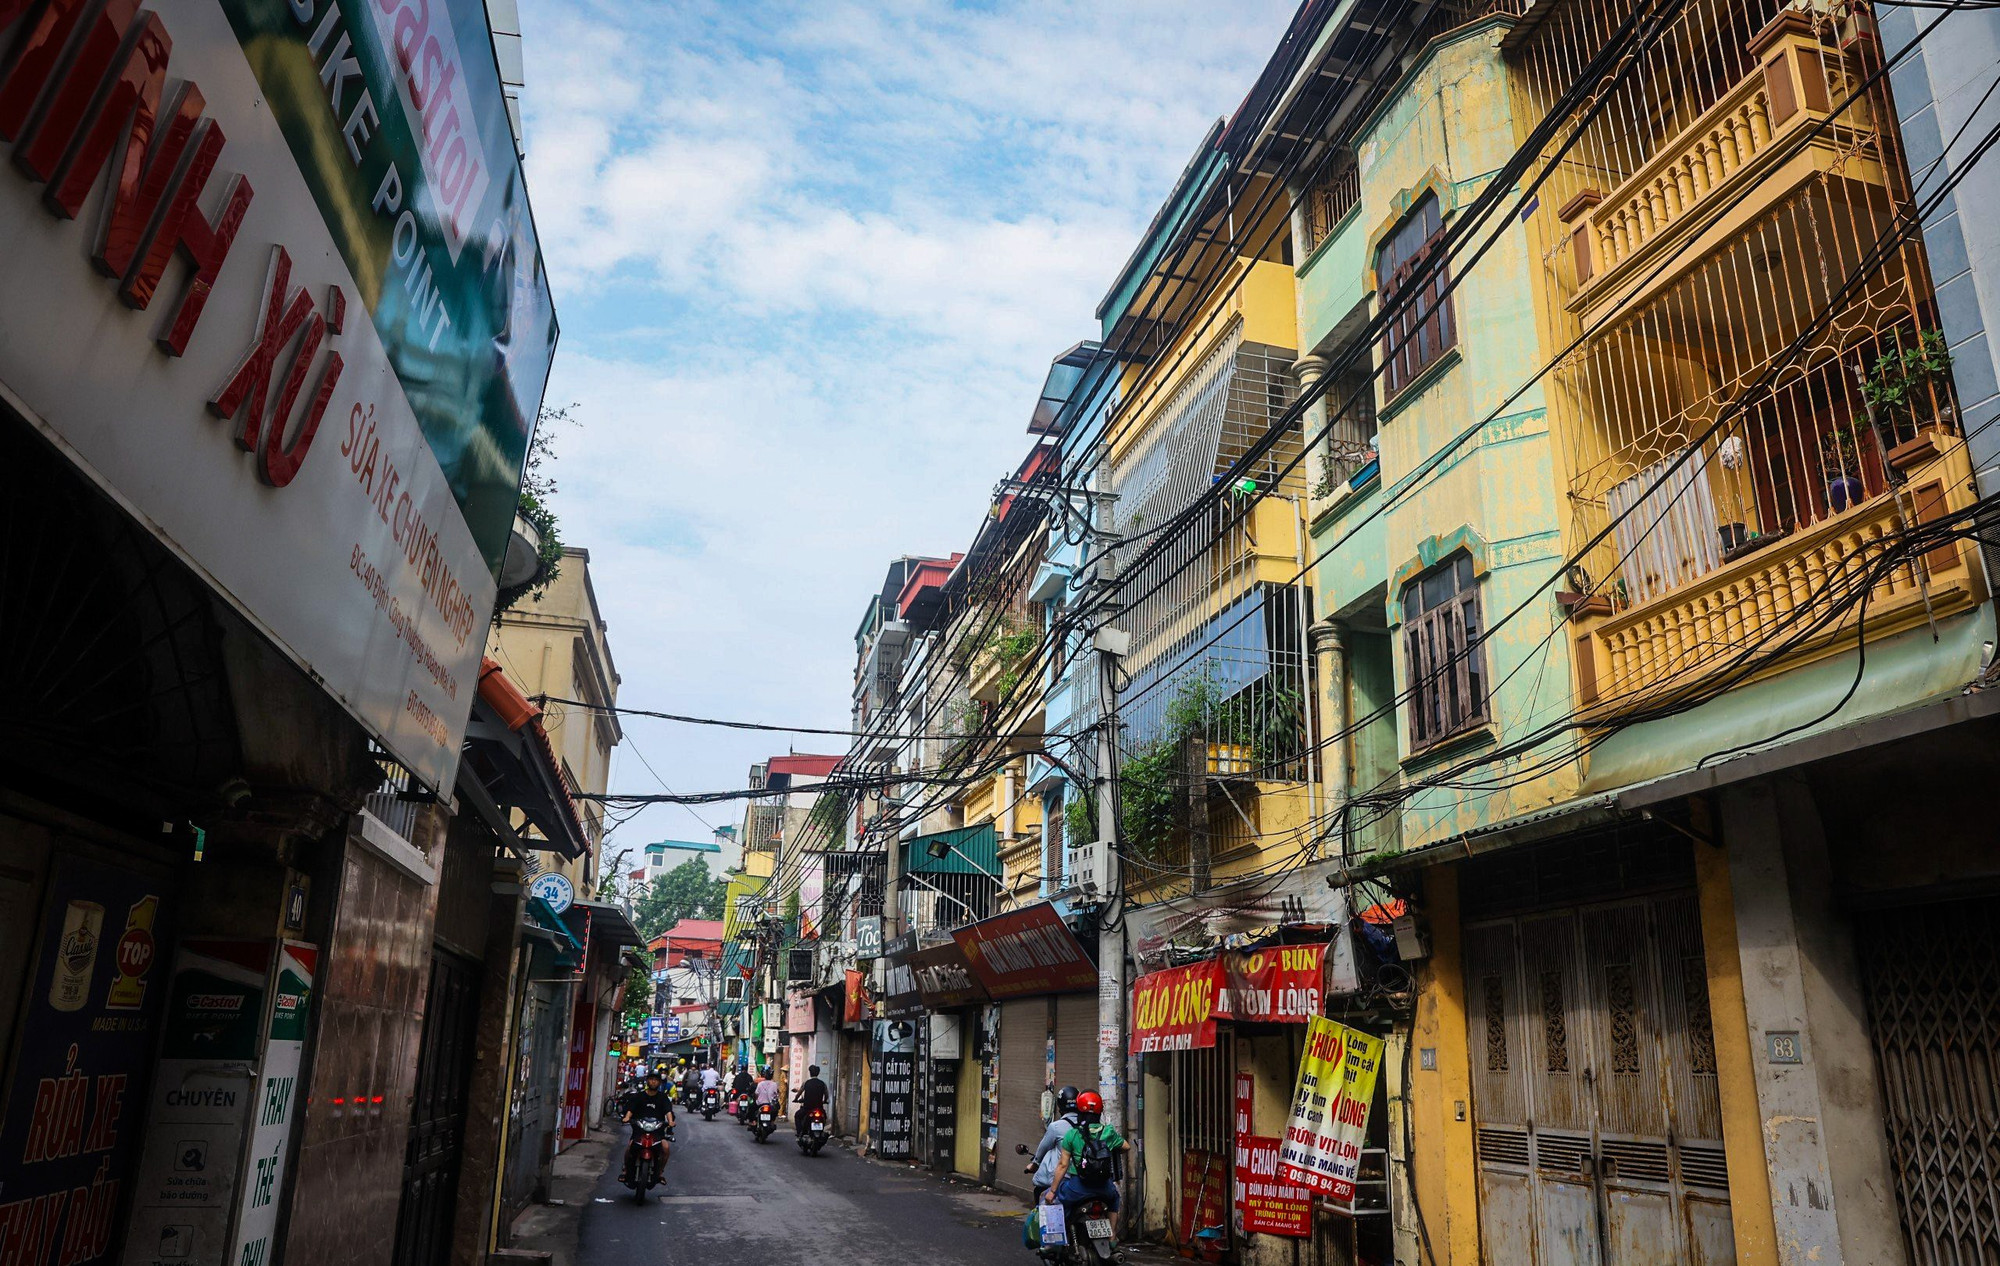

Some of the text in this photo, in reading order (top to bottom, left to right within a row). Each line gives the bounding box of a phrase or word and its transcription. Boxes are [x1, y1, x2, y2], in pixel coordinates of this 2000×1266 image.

[382, 0, 480, 241] astrol
[372, 160, 451, 354] POINT
[341, 401, 475, 653] SỬA XE CHUYÊN NGHIỆP
[543, 886, 559, 899] 34
[291, 893, 303, 922] 40
[122, 941, 151, 966] TOP
[1281, 945, 1318, 972] BÚN
[200, 995, 241, 1009] Castrol
[1136, 978, 1170, 1030] CHÁO
[1169, 969, 1213, 1026] LÒNG
[1277, 981, 1319, 1016] LÒNG
[91, 1017, 118, 1032] MADE
[118, 1017, 127, 1031] IN
[1141, 1031, 1161, 1053] TIẾT
[1162, 1033, 1193, 1050] CANH
[1347, 1034, 1369, 1054] Lòng
[1774, 1038, 1795, 1058] 83
[886, 1057, 911, 1076] CẮT TÓC
[1422, 1052, 1432, 1066] 81
[166, 1087, 236, 1107] CHUYÊN
[885, 1080, 900, 1094] NAM
[23, 1042, 127, 1165] RỬA XE
[261, 1077, 294, 1127] THAY
[1319, 1135, 1338, 1156] VỊT
[1337, 1141, 1359, 1162] LỘN
[252, 1139, 282, 1208] THẾ
[1317, 1158, 1345, 1177] MANG
[1249, 1181, 1263, 1196] BÚN
[1320, 1178, 1333, 1192] 94
